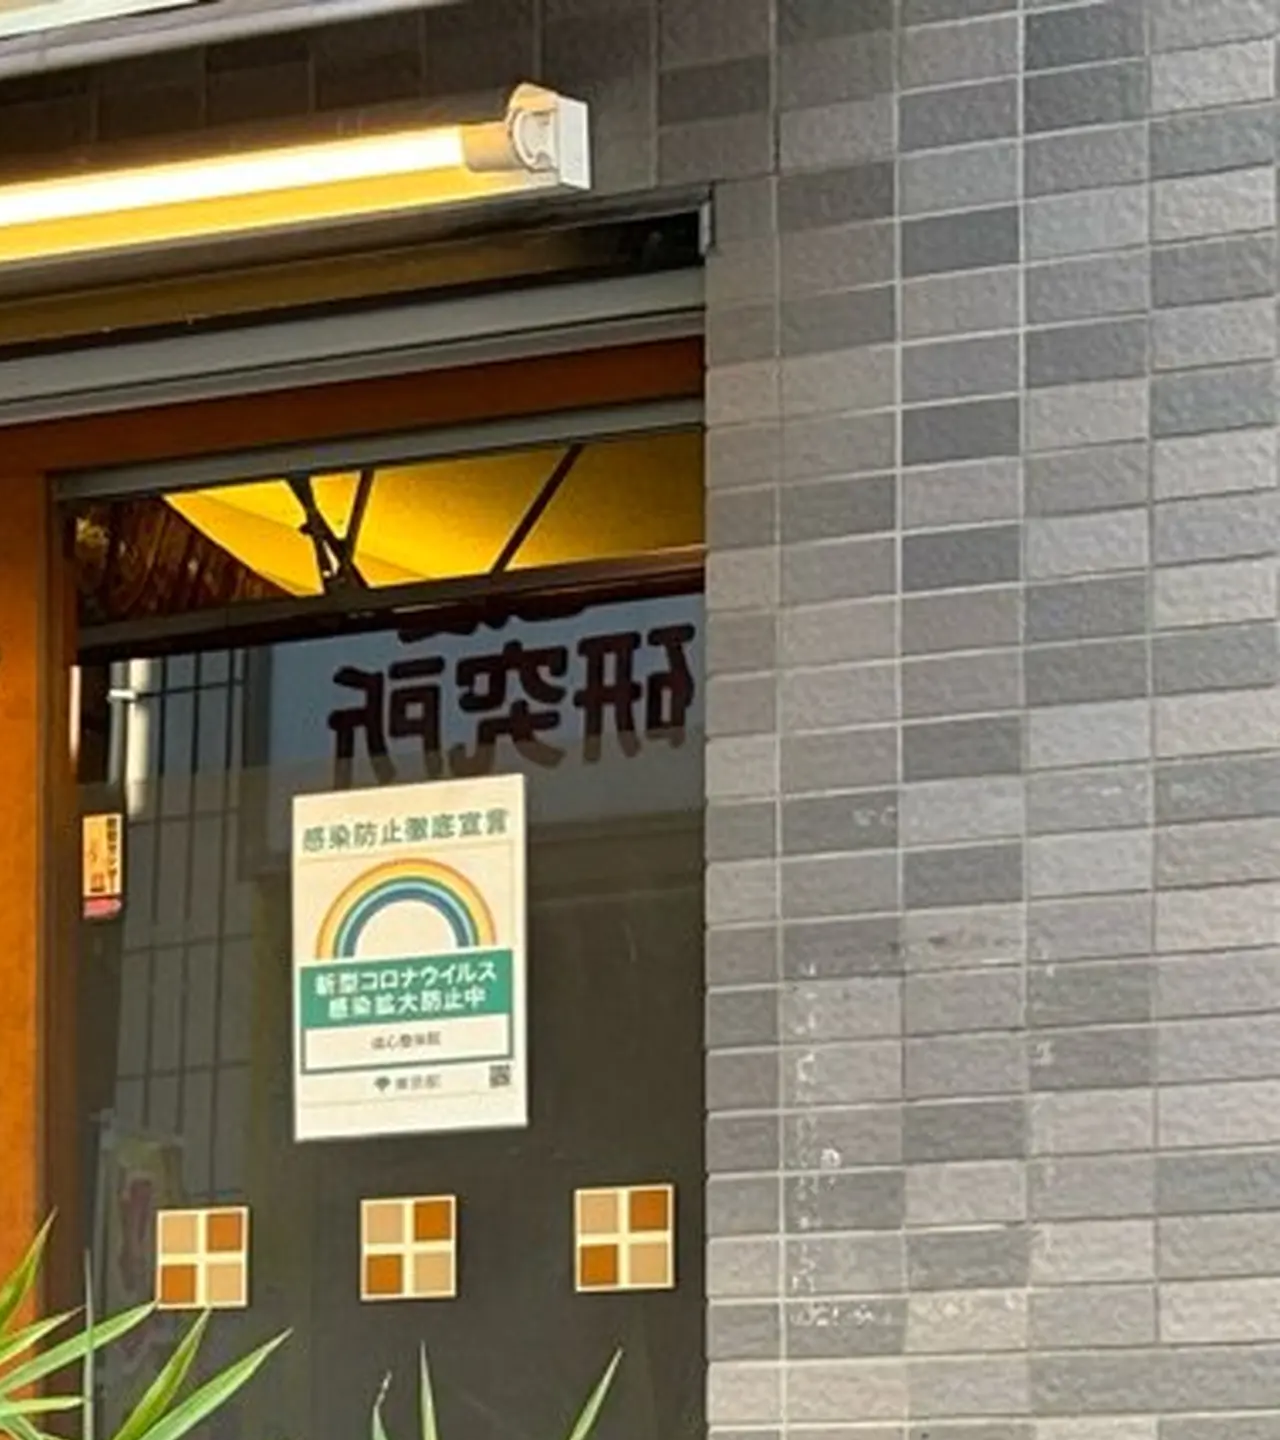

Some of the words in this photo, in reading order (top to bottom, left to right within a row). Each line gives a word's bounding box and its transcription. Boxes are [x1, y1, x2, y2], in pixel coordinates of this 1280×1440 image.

[301, 807, 510, 853] 感染防止徹底宣言
[313, 959, 499, 997] 新型コロナウイルス
[327, 984, 488, 1020] 感染拡大防止中
